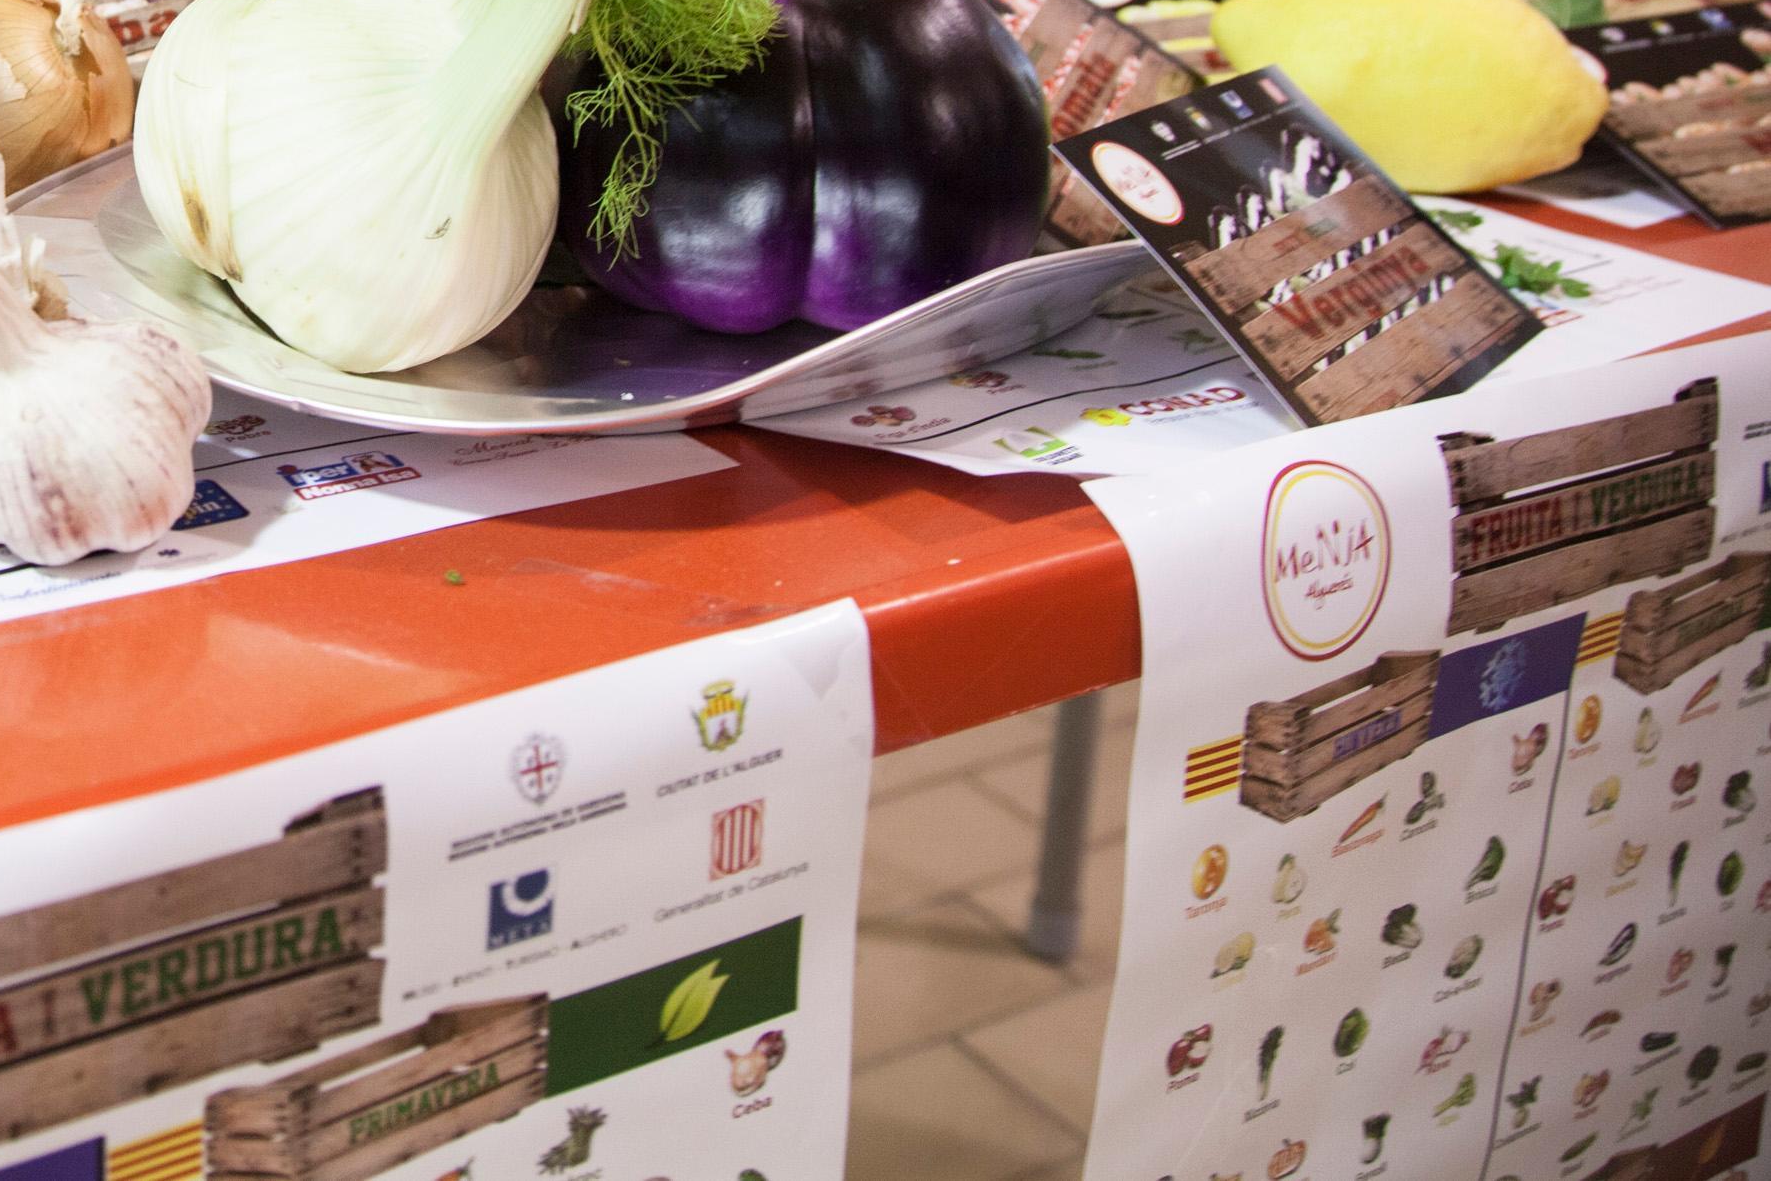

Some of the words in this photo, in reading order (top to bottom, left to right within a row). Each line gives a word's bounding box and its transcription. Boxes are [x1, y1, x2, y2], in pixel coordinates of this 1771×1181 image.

[302, 476, 376, 499] Nonna
[1470, 496, 1563, 562] FRUITA
[41, 988, 59, 1037] I
[80, 905, 344, 1025] VERDURA
[348, 1062, 500, 1144] PRIMAVERA
[732, 1095, 774, 1120] Ceba
